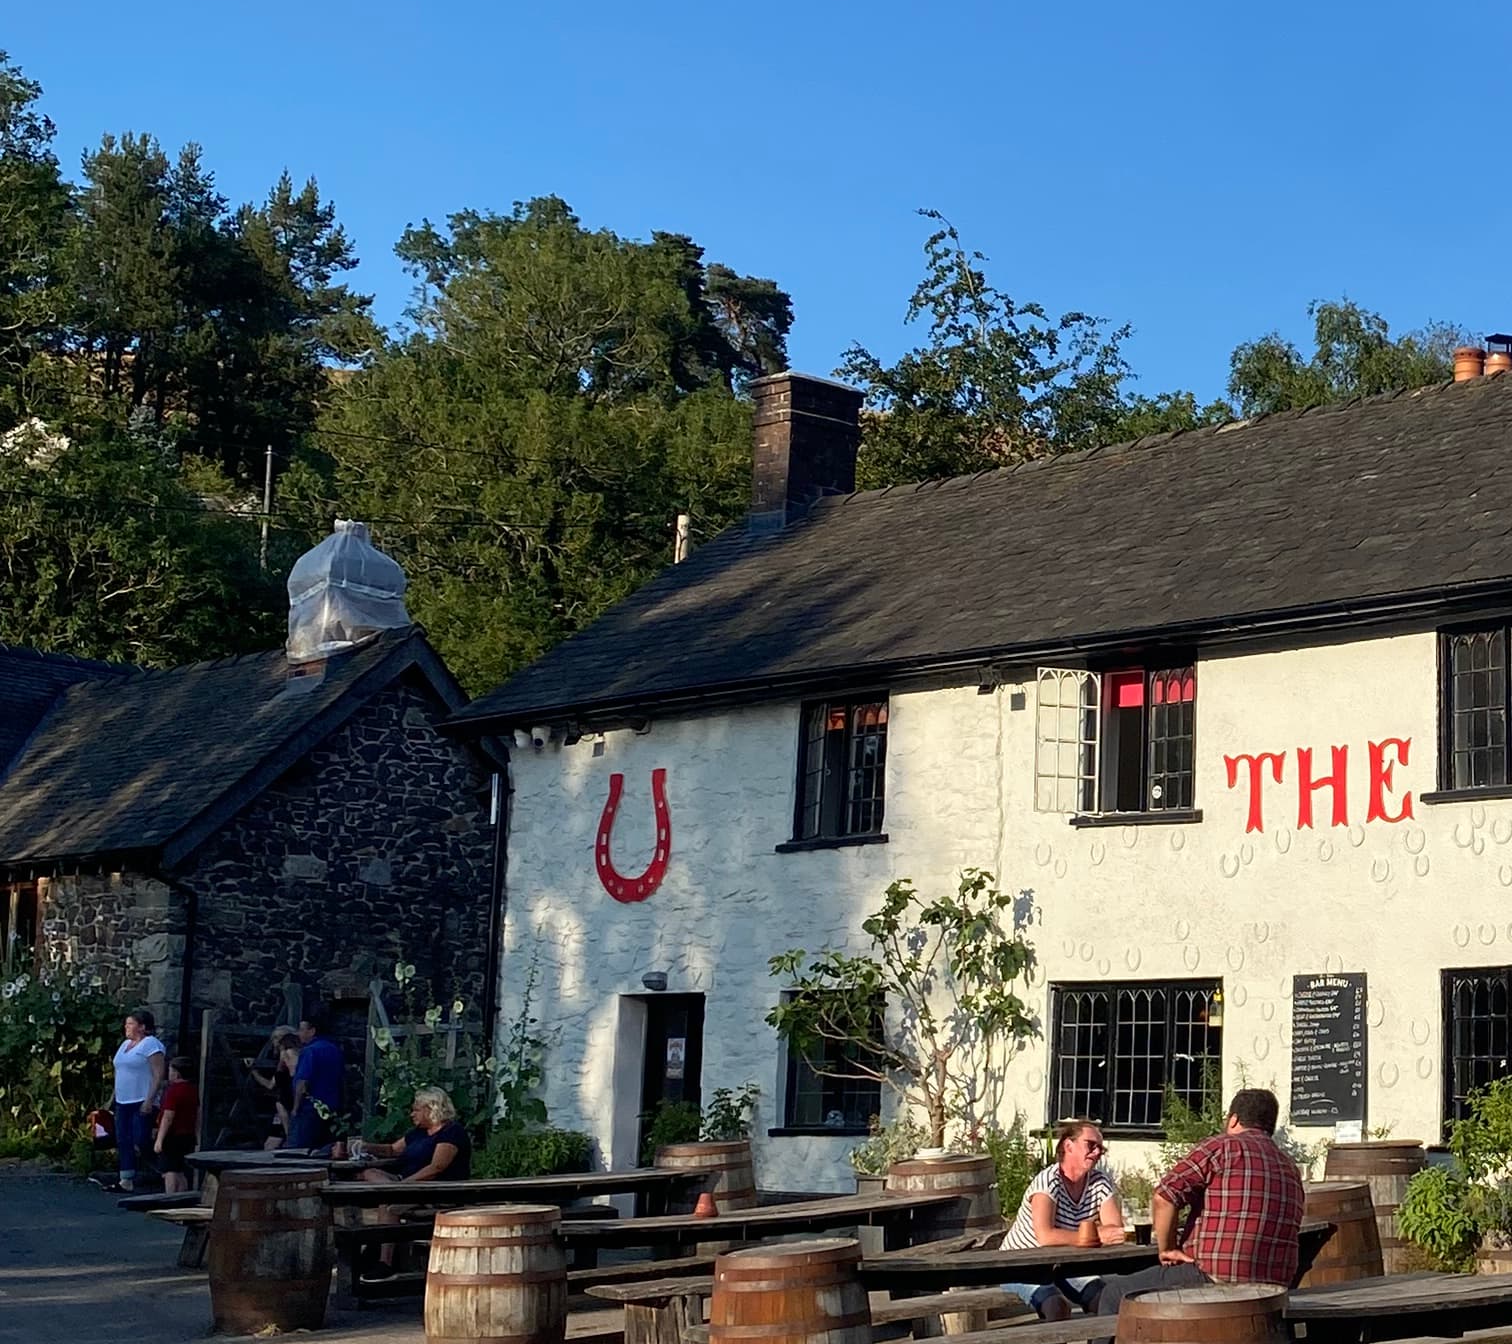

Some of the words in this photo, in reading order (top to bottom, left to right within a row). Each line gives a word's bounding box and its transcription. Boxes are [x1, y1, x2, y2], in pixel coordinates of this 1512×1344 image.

[1223, 737, 1414, 834] THE
[1310, 978, 1325, 989] BAR
[1326, 977, 1349, 988] MENU
